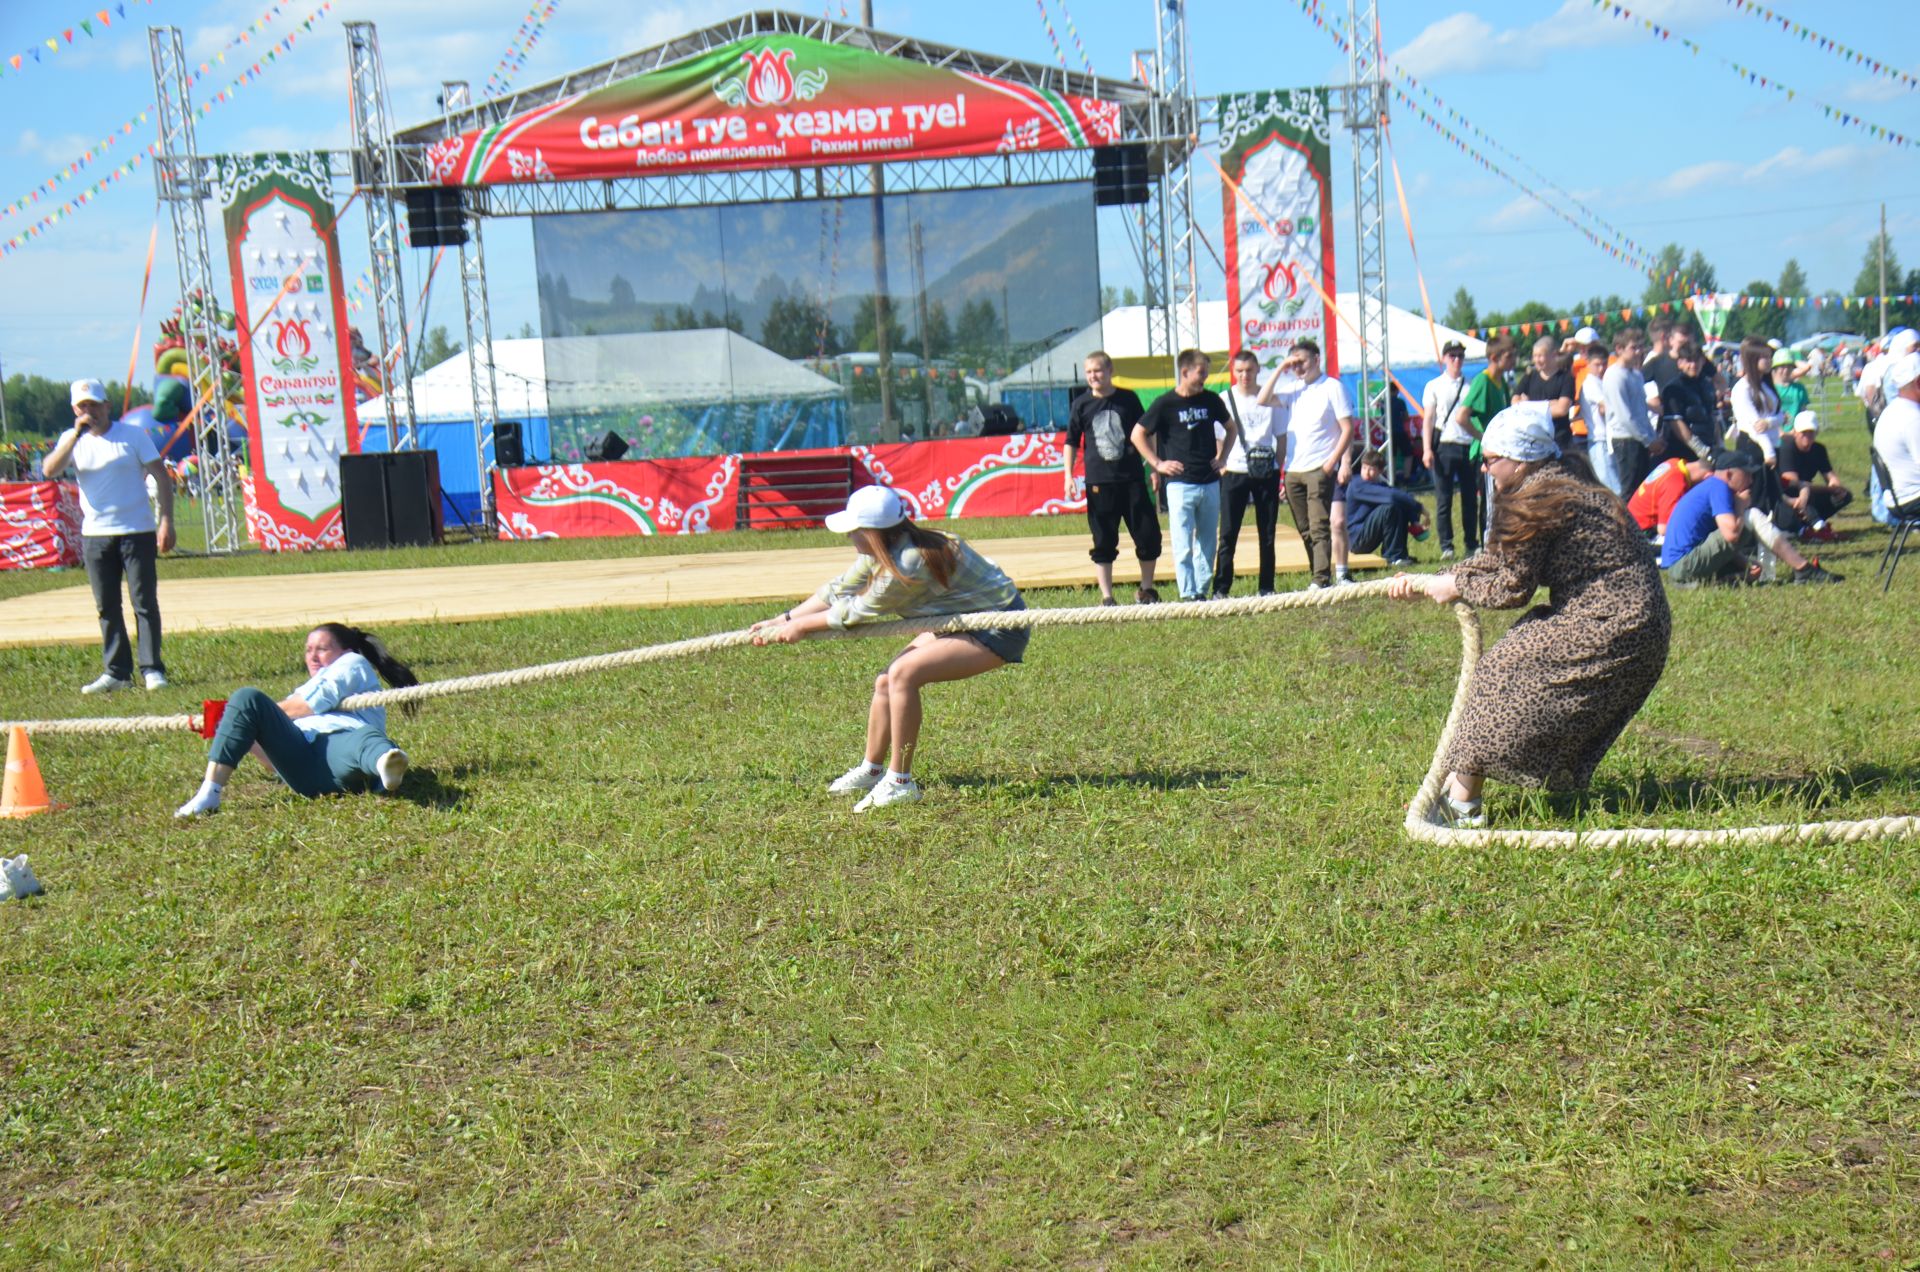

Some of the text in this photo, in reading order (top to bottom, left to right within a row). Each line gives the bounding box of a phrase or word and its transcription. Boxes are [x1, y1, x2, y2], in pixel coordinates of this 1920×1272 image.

[580, 114, 684, 149] Сабан
[692, 116, 748, 144] туе
[775, 107, 893, 137] хезмәт
[902, 94, 967, 132] туе!
[636, 140, 786, 166] Добро пожаловать!
[1245, 312, 1320, 338] Сабантуй
[1271, 338, 1296, 347] 2024
[260, 369, 336, 395] Сабантуй
[287, 395, 313, 405] 2024
